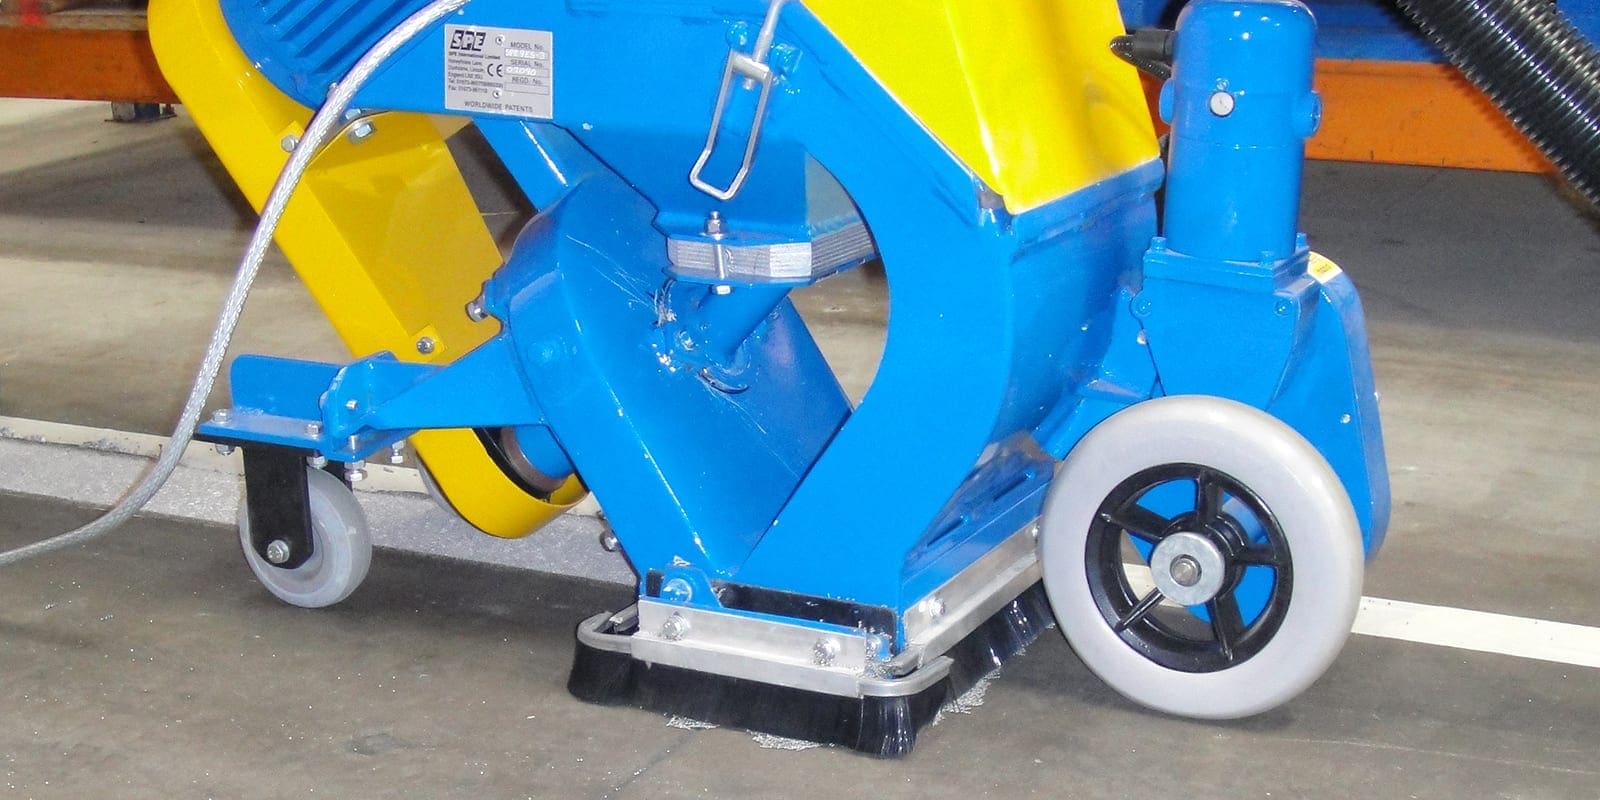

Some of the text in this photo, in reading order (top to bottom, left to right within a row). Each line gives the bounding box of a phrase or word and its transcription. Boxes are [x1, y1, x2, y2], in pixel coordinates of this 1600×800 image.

[450, 29, 486, 51] SPE
[510, 42, 532, 50] MODEL
[510, 59, 532, 67] SERIAL
[487, 63, 503, 77] CE
[464, 101, 534, 113] WORLDWIDE PATENTS
